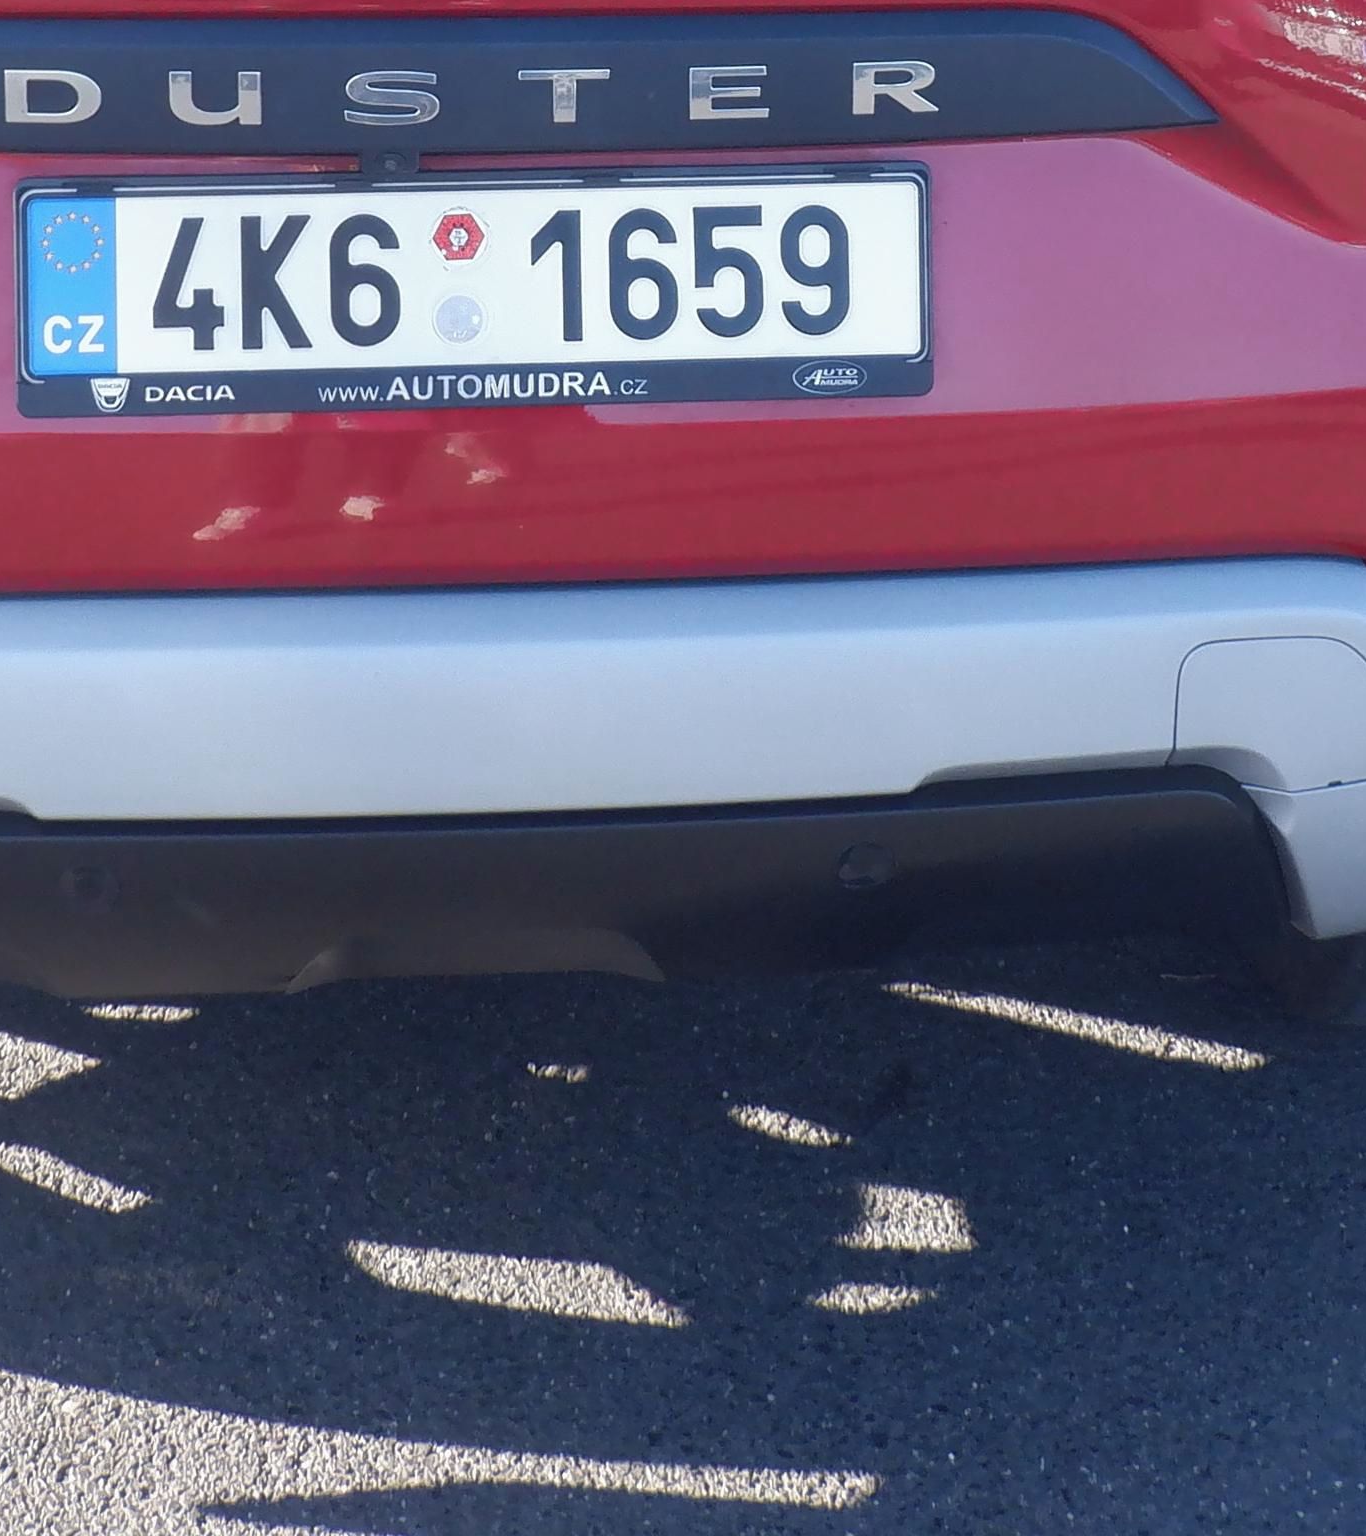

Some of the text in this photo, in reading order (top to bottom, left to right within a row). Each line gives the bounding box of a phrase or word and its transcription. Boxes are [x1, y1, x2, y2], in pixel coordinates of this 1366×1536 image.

[3, 61, 940, 126] DUSTER
[151, 203, 851, 351] 4K6 1659
[43, 314, 106, 354] CZ
[144, 384, 236, 403] DACIA
[801, 367, 859, 386] AUTO
